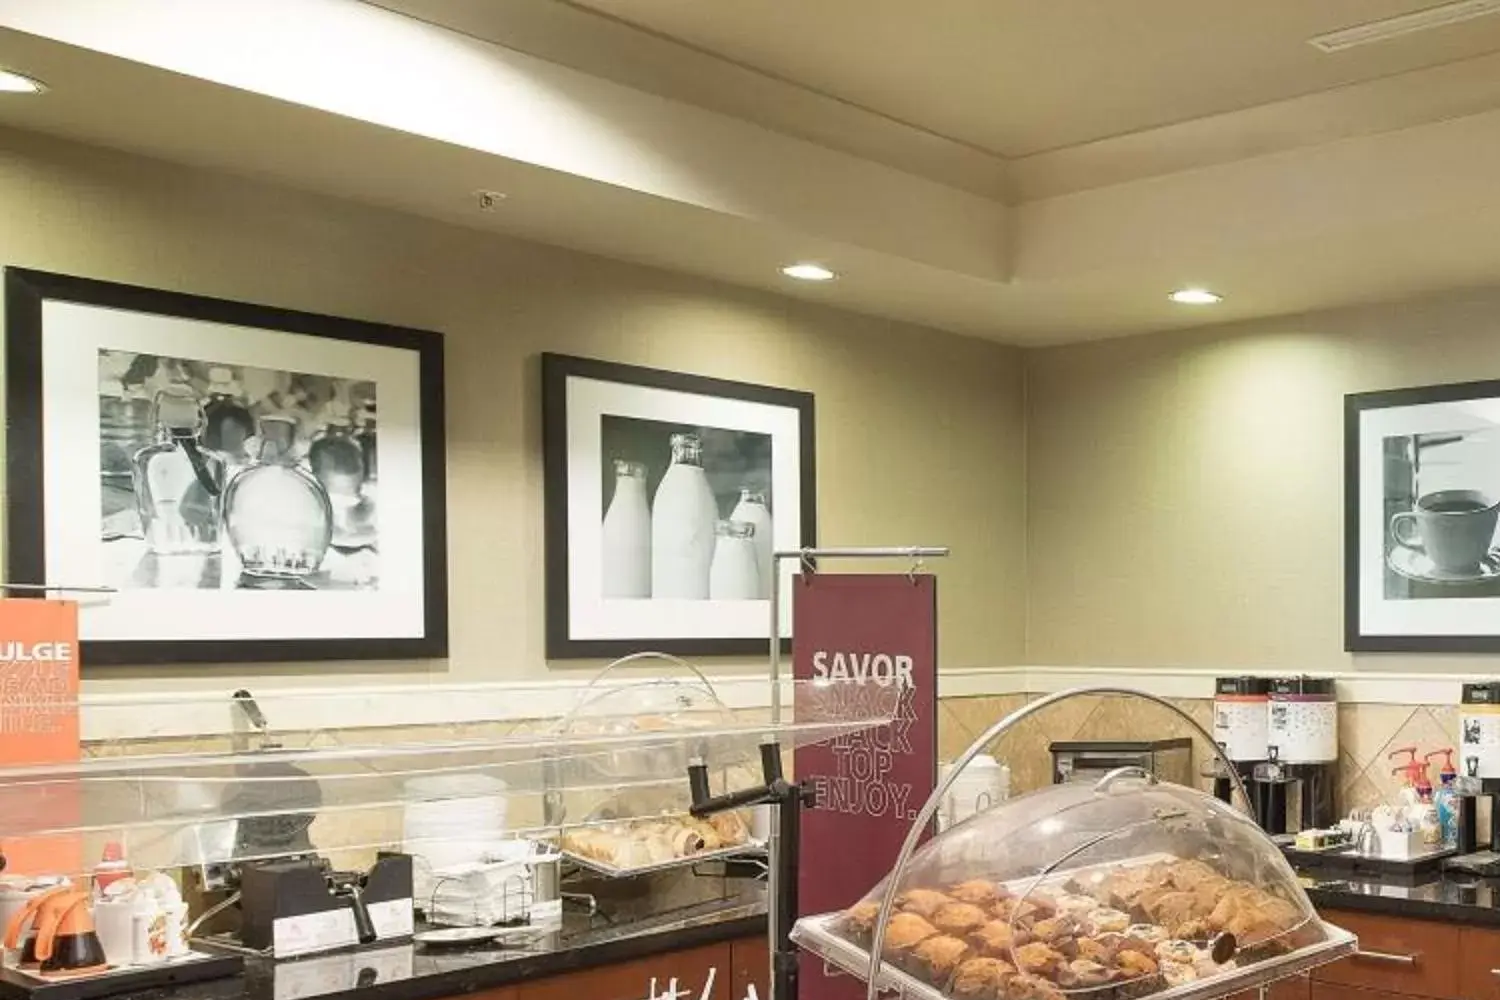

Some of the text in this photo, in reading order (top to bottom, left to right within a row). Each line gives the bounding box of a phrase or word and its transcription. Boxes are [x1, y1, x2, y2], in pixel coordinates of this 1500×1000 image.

[813, 652, 913, 688] SAVOR
[815, 718, 914, 754] TACK
[832, 746, 893, 782] TOP
[809, 774, 919, 820] ENJOY.
